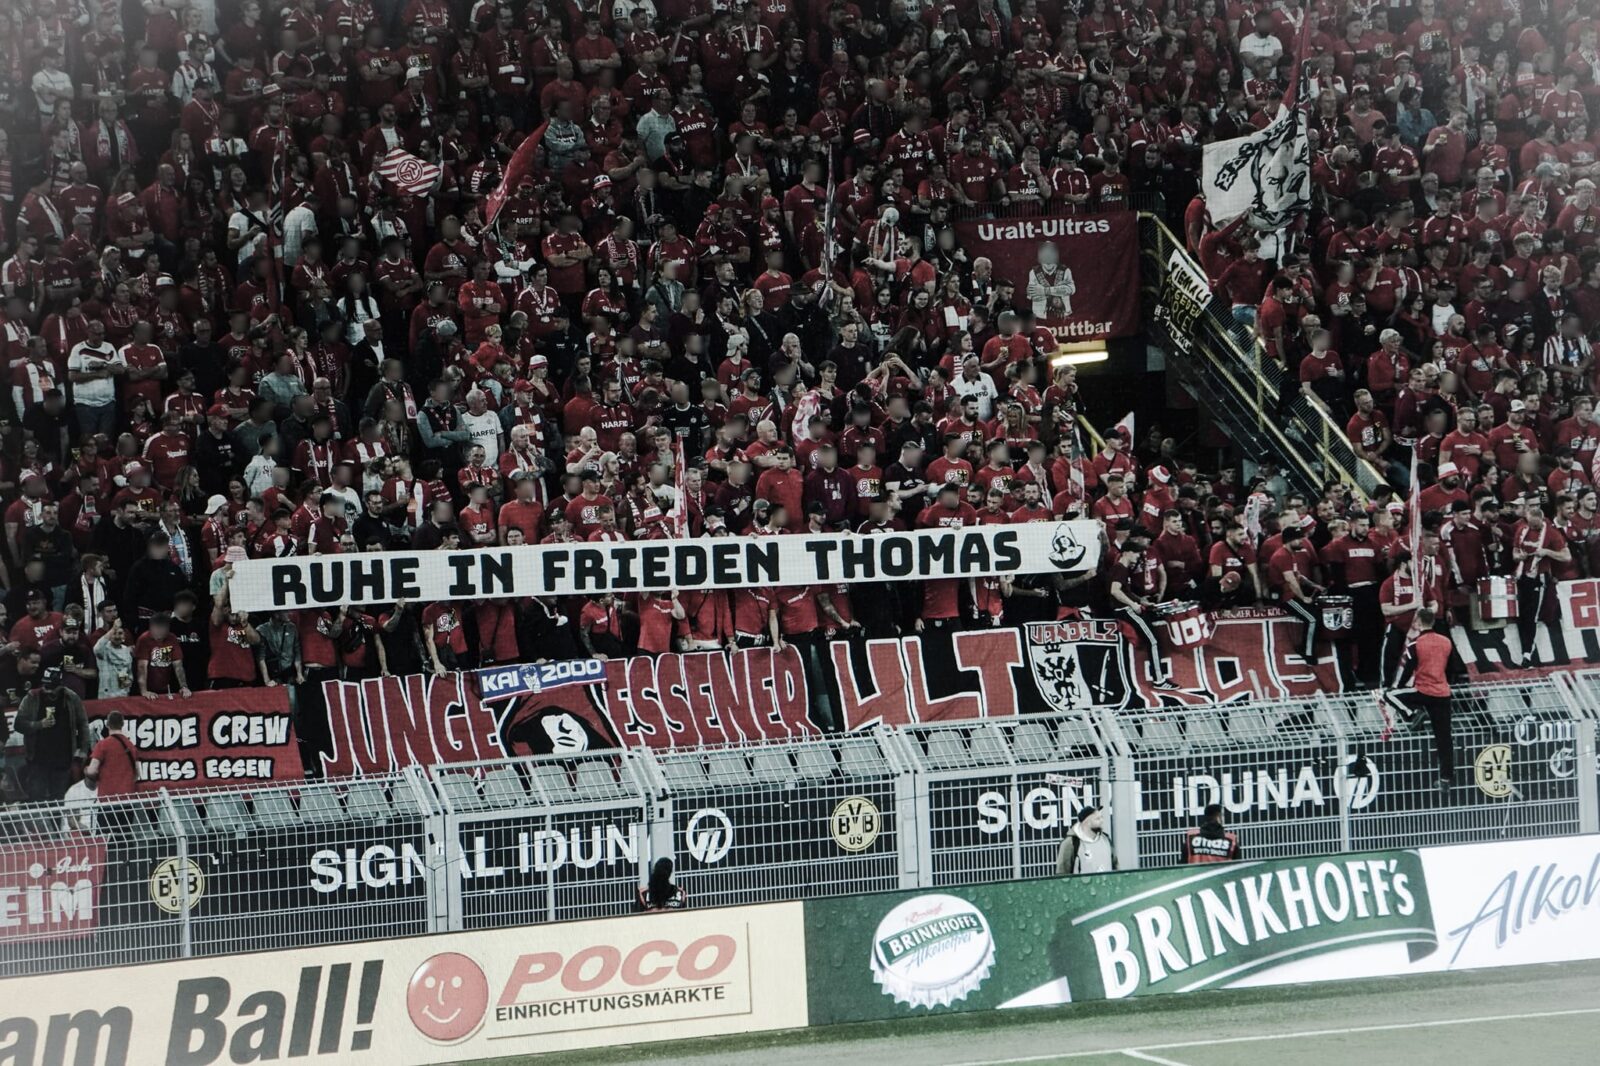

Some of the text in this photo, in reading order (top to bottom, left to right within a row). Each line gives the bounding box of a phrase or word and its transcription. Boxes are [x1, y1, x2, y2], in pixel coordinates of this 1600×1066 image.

[978, 218, 1111, 241] Uralt-Ultras
[1050, 320, 1112, 337] puttbar
[272, 530, 1022, 606] RUHE IN FRIEDEN THOMAS
[481, 659, 603, 693] KAI 2000
[212, 715, 289, 746] CREW
[320, 672, 513, 782] JUNGE
[604, 643, 825, 752] ESSENER
[206, 759, 272, 779] ESSEN
[977, 766, 1325, 834] SIGNL IDUNA
[838, 802, 874, 836] BVB
[518, 820, 660, 874] IDUN
[497, 934, 737, 1007] POCO
[165, 959, 384, 1066] Ball!
[496, 985, 725, 1022] EINRICHTUNGSMÄRKTE
